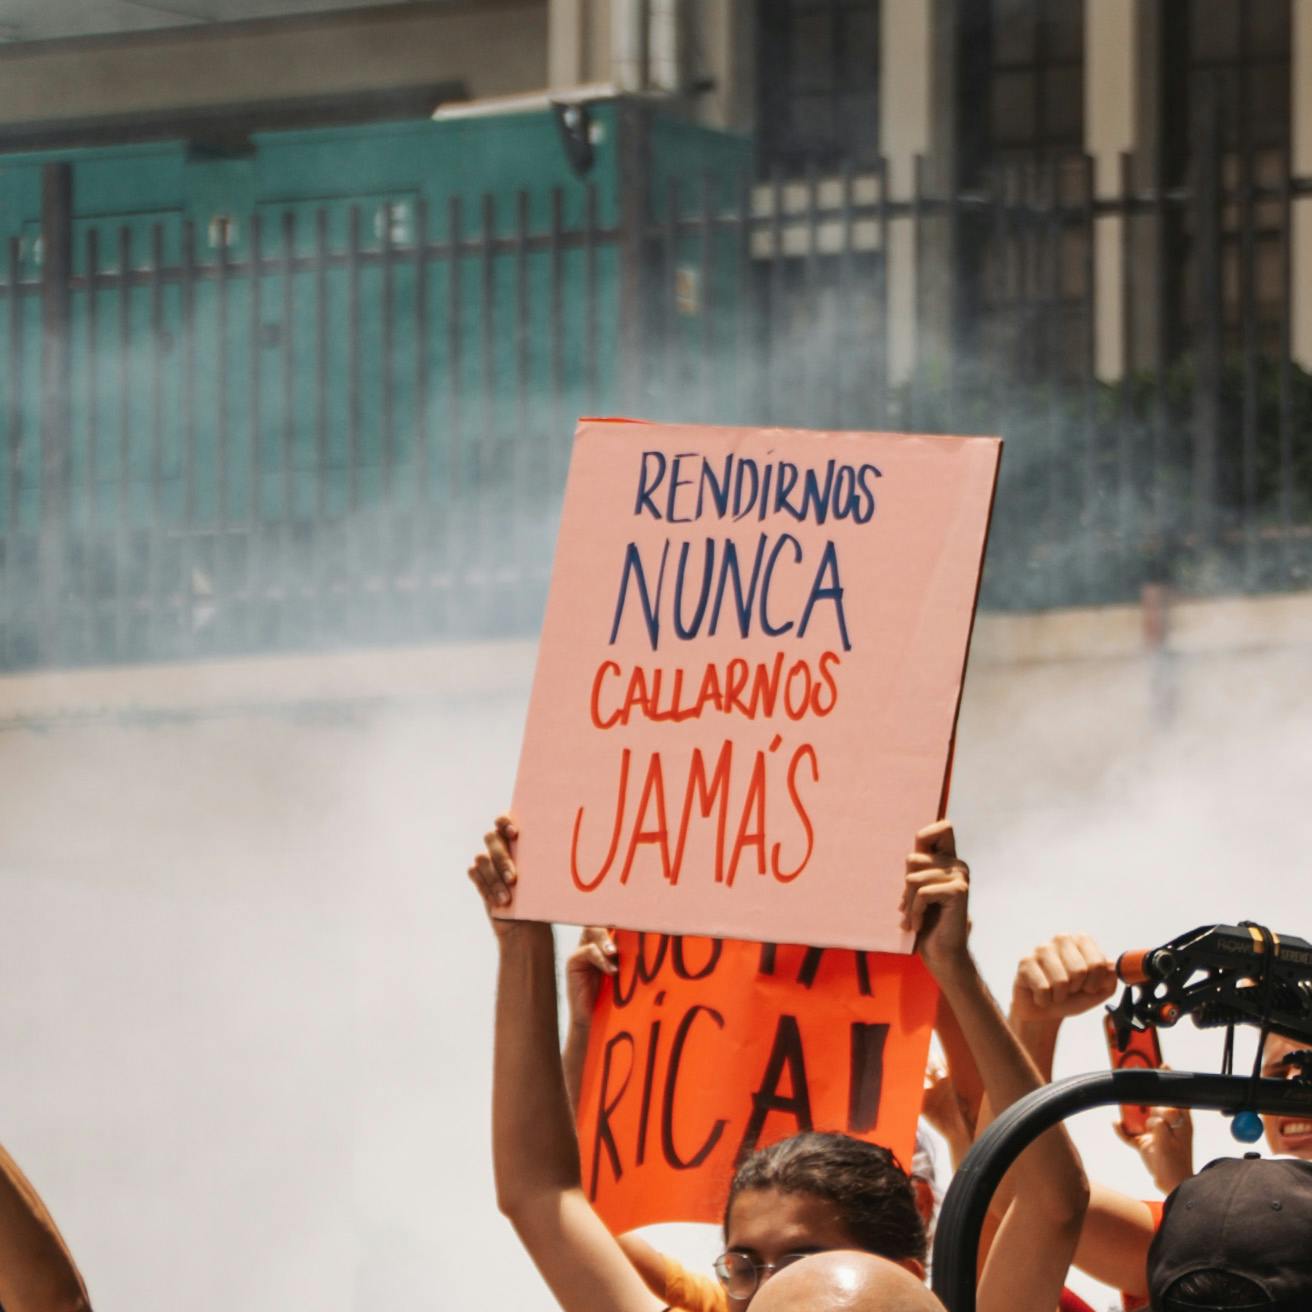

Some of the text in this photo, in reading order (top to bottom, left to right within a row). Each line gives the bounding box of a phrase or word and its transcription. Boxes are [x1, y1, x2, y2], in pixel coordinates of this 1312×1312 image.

[634, 450, 882, 525] RENDIRNOS
[609, 532, 852, 651] NUNCA
[590, 651, 841, 730] CALLARNOS
[569, 733, 819, 893] JAMÁS
